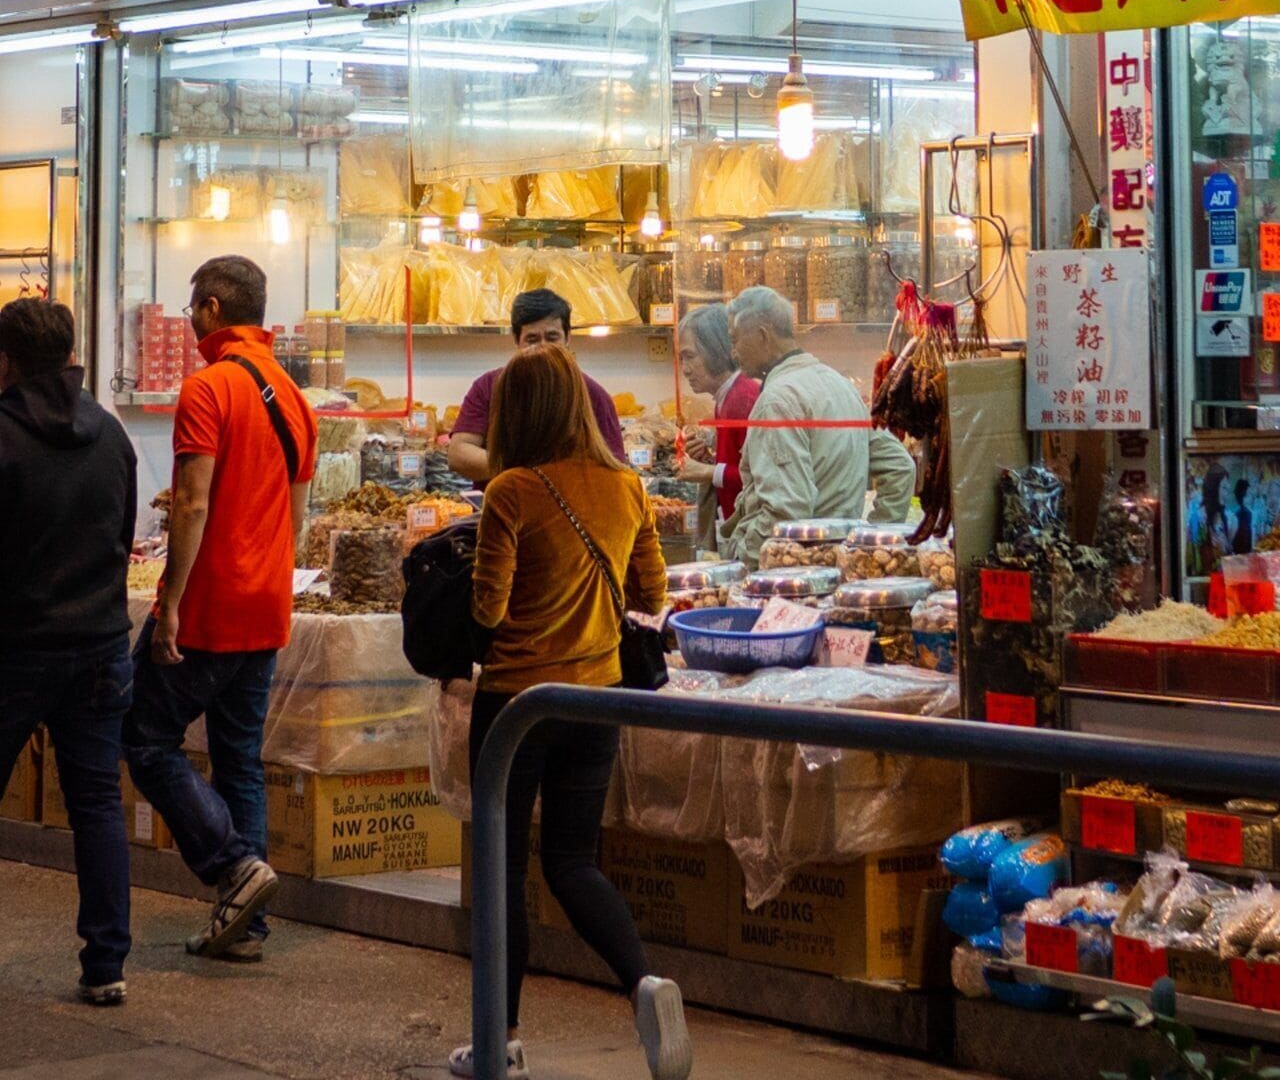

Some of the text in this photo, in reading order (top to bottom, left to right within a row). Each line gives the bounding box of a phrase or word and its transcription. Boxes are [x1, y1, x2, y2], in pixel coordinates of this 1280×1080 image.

[1210, 190, 1232, 206] ADT
[1062, 263, 1119, 284] 野生
[1076, 288, 1105, 384] 茶籽油
[390, 788, 440, 809] HOKKAID
[332, 813, 416, 839] NW 20KG
[637, 877, 676, 899] 20KG
[771, 899, 814, 924] 20KG
